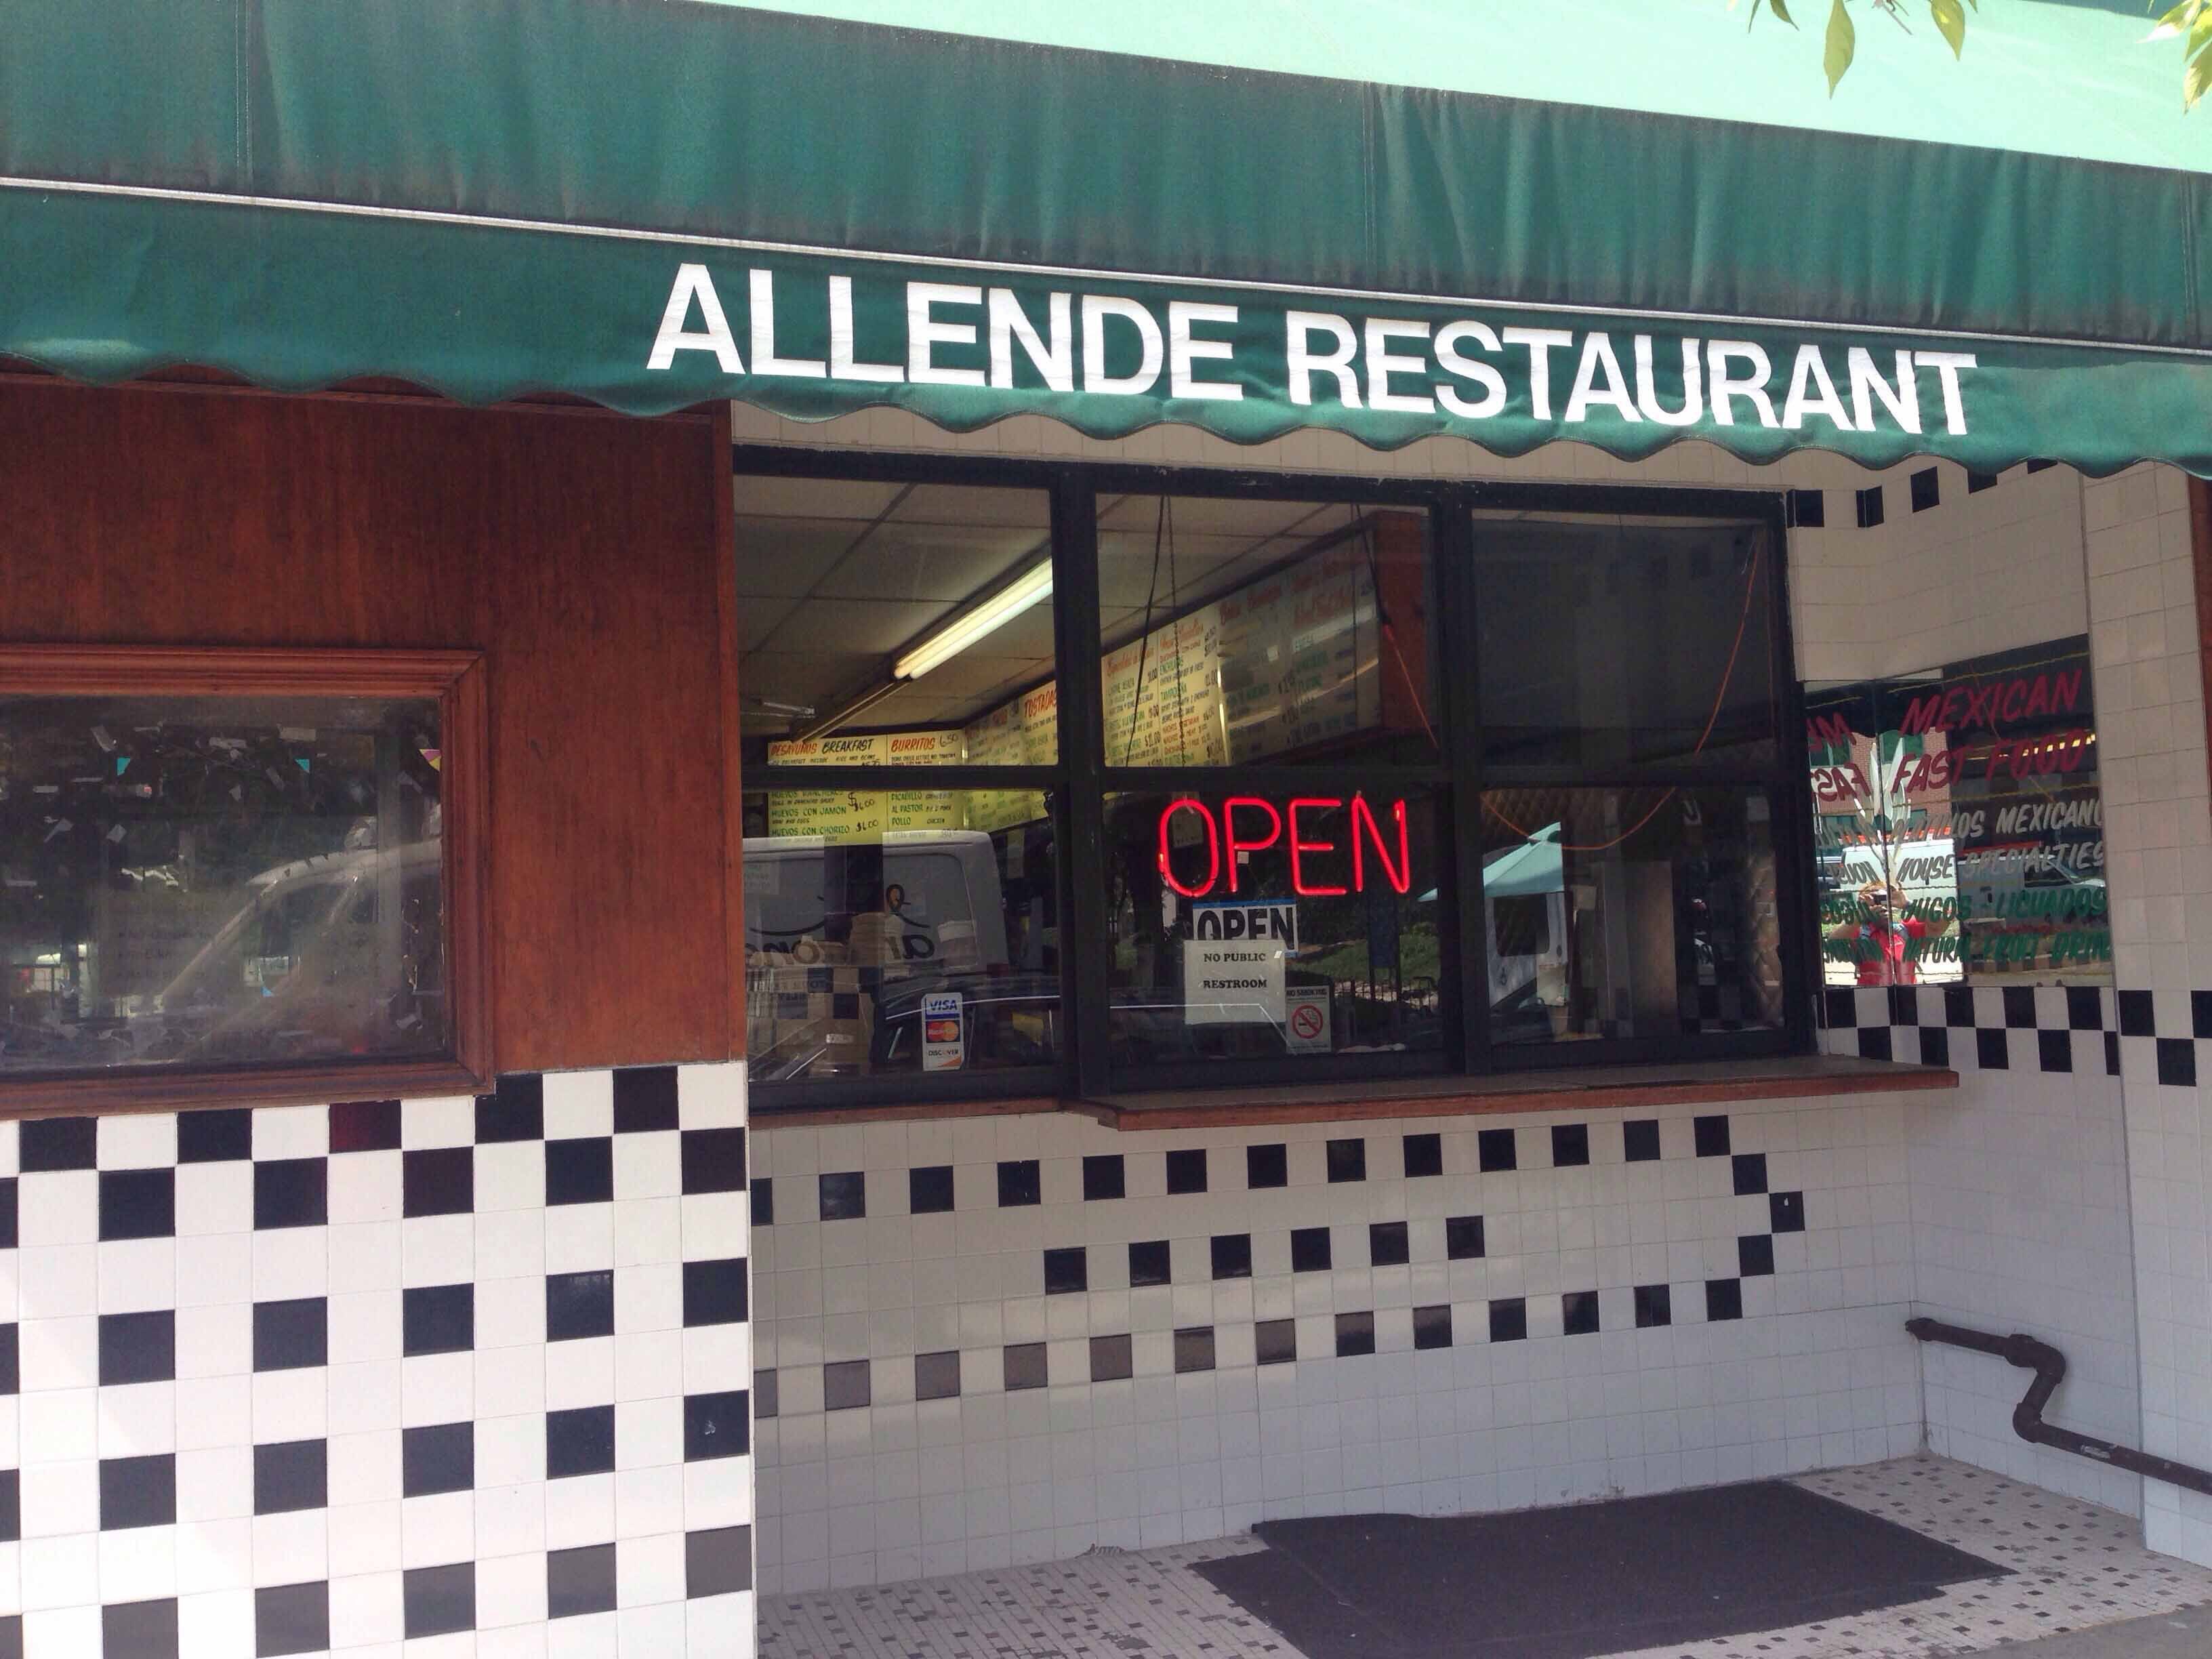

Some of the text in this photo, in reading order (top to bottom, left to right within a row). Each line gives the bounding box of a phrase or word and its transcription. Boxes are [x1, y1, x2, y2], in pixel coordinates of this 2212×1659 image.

[647, 263, 1978, 435] ALLENDE RESTAURANT
[1899, 672, 2082, 737] MEXICAN
[822, 738, 874, 754] BREAKFAST
[891, 737, 935, 752] BURRITOS
[1891, 728, 2087, 793] FAST FOOD
[803, 808, 817, 816] CON
[900, 804, 923, 813] PASTOR
[892, 817, 911, 825] POLLO
[771, 827, 798, 836] HUEVOS
[802, 827, 817, 836] CON
[819, 825, 850, 834] CHORIZO
[1157, 796, 1410, 898] OPEN
[1896, 840, 2104, 884] HOUSE SPECIALTIES
[1901, 887, 2106, 924] JUGOS LICUADOS
[1197, 906, 1295, 950] OPEN
[1203, 952, 1266, 962] NO PUBLIC
[1203, 979, 1267, 989] RESTROOM
[930, 1000, 958, 1010] VISA
